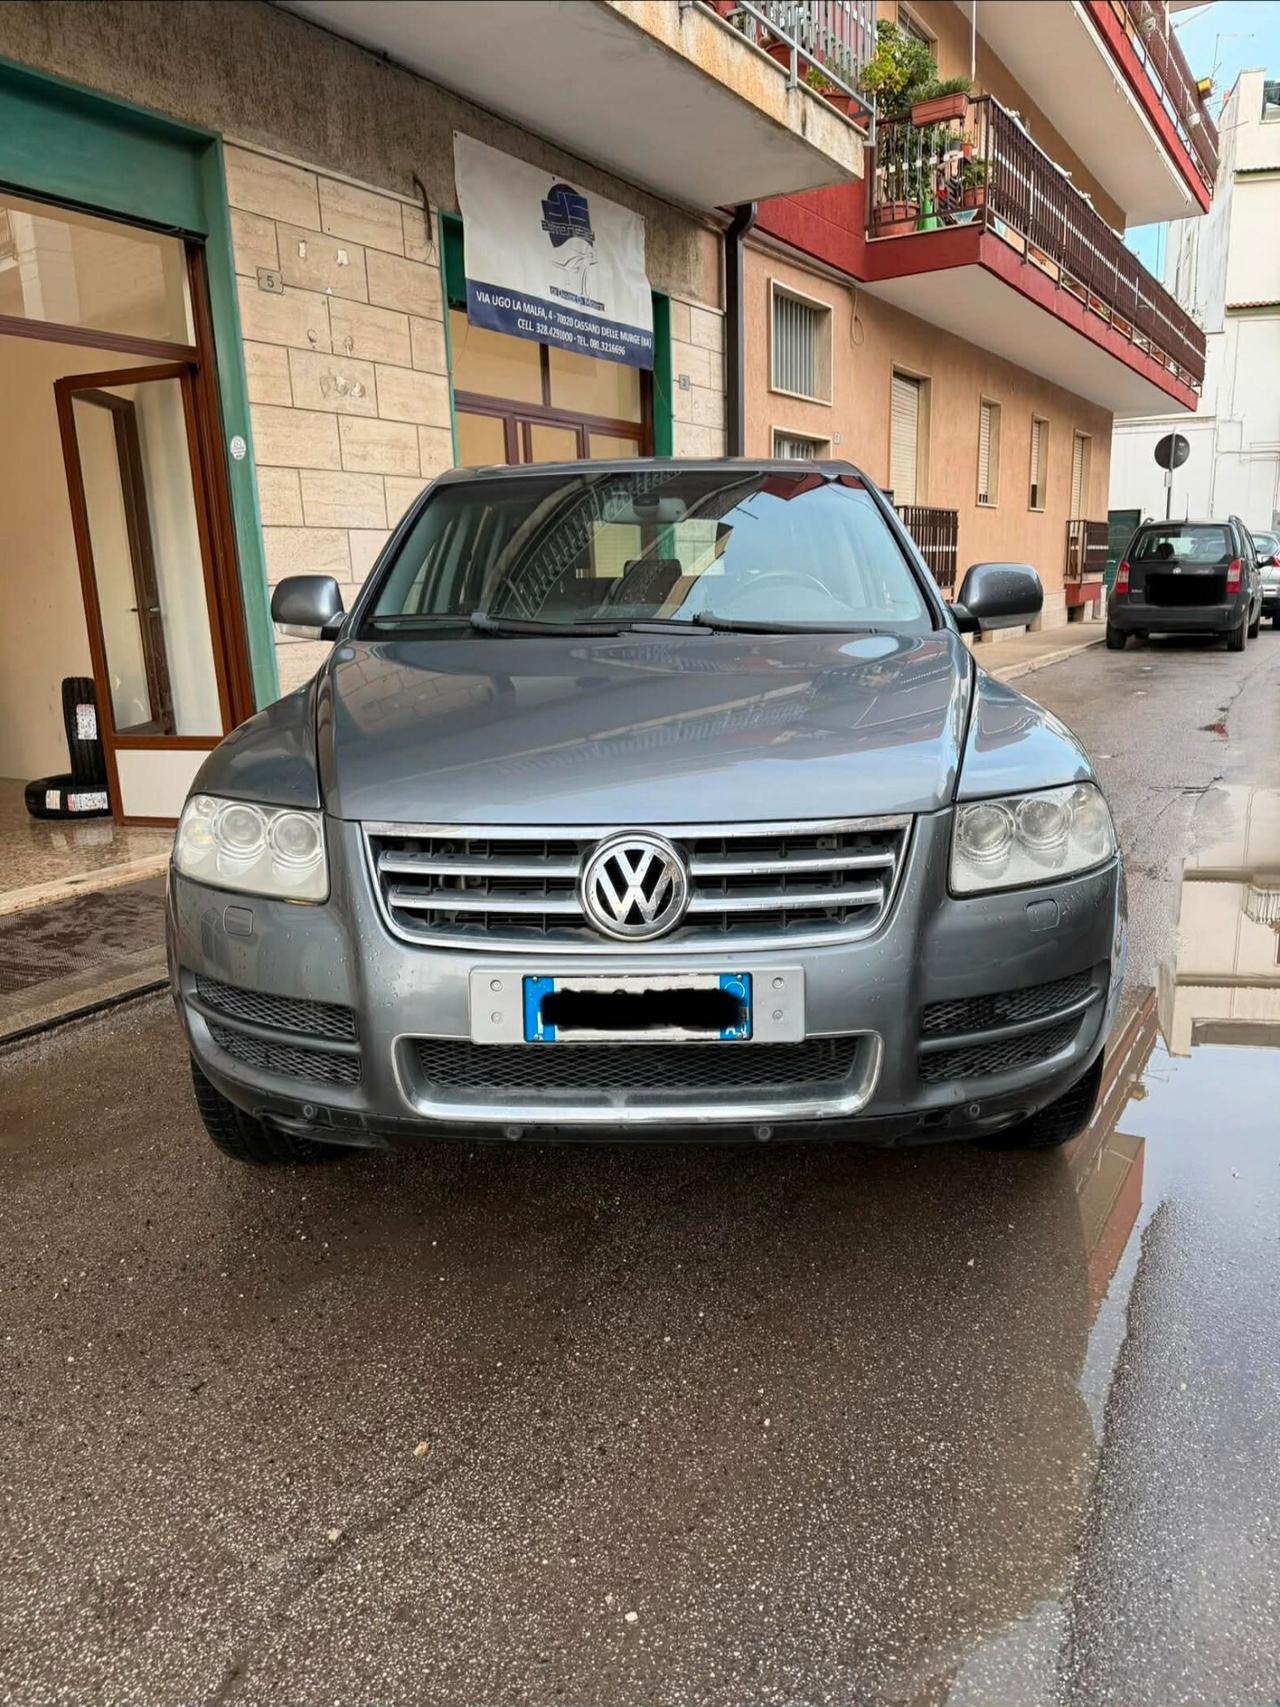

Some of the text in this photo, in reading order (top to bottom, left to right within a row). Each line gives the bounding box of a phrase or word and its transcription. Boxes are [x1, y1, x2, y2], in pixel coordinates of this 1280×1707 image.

[267, 275, 274, 289] 5
[476, 290, 490, 304] VIA
[492, 295, 511, 309] UGO
[512, 300, 522, 311] LA
[523, 303, 547, 320] MALFA,
[548, 310, 553, 320] 4
[557, 313, 573, 327] 70020
[574, 320, 600, 335] CASSANO
[602, 327, 619, 339] DELLE
[621, 331, 640, 345] MURGE
[641, 335, 652, 349] (BA)
[518, 318, 534, 332] CELL.
[577, 336, 589, 348] TEL.
[591, 841, 680, 932] VW
